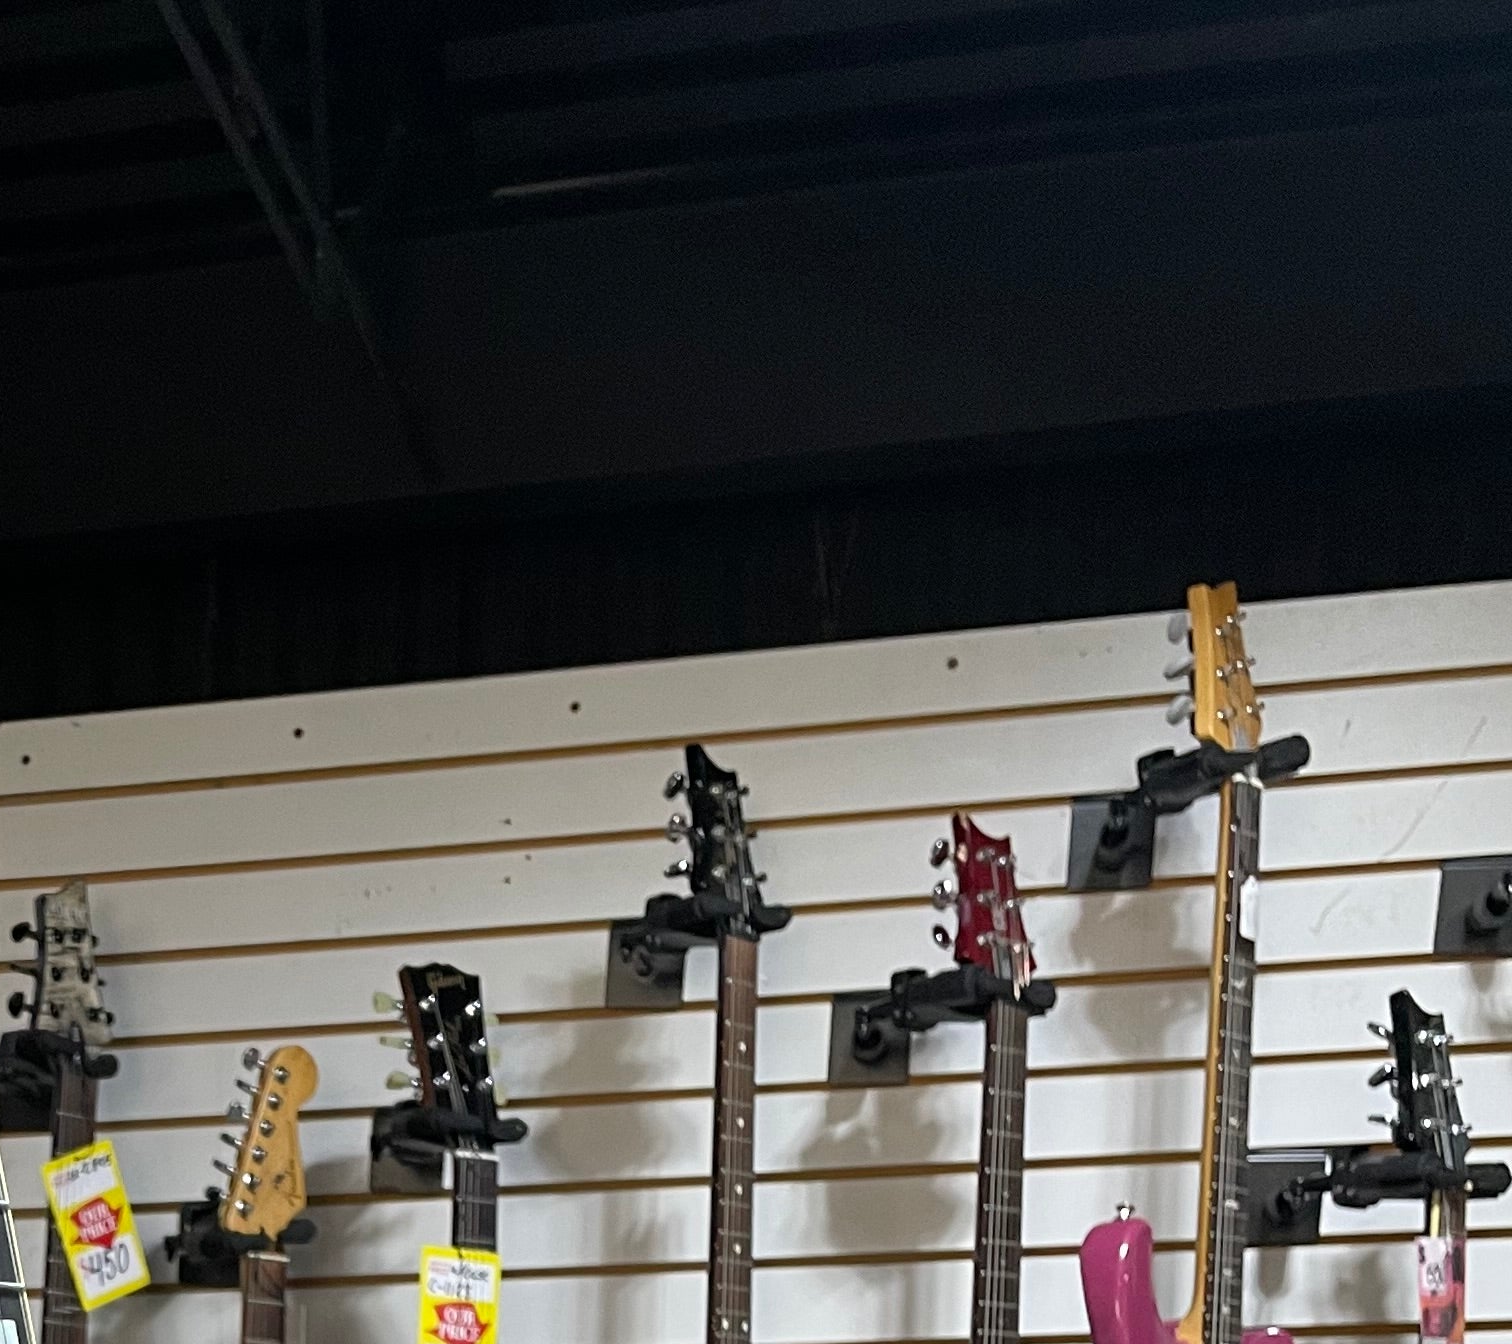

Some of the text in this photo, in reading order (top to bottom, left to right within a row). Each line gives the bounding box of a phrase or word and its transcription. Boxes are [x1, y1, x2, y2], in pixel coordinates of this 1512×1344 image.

[77, 1202, 113, 1227] OUR
[79, 1215, 120, 1244] PRICE
[442, 1306, 477, 1327] OUR
[437, 1323, 482, 1343] PRICE
